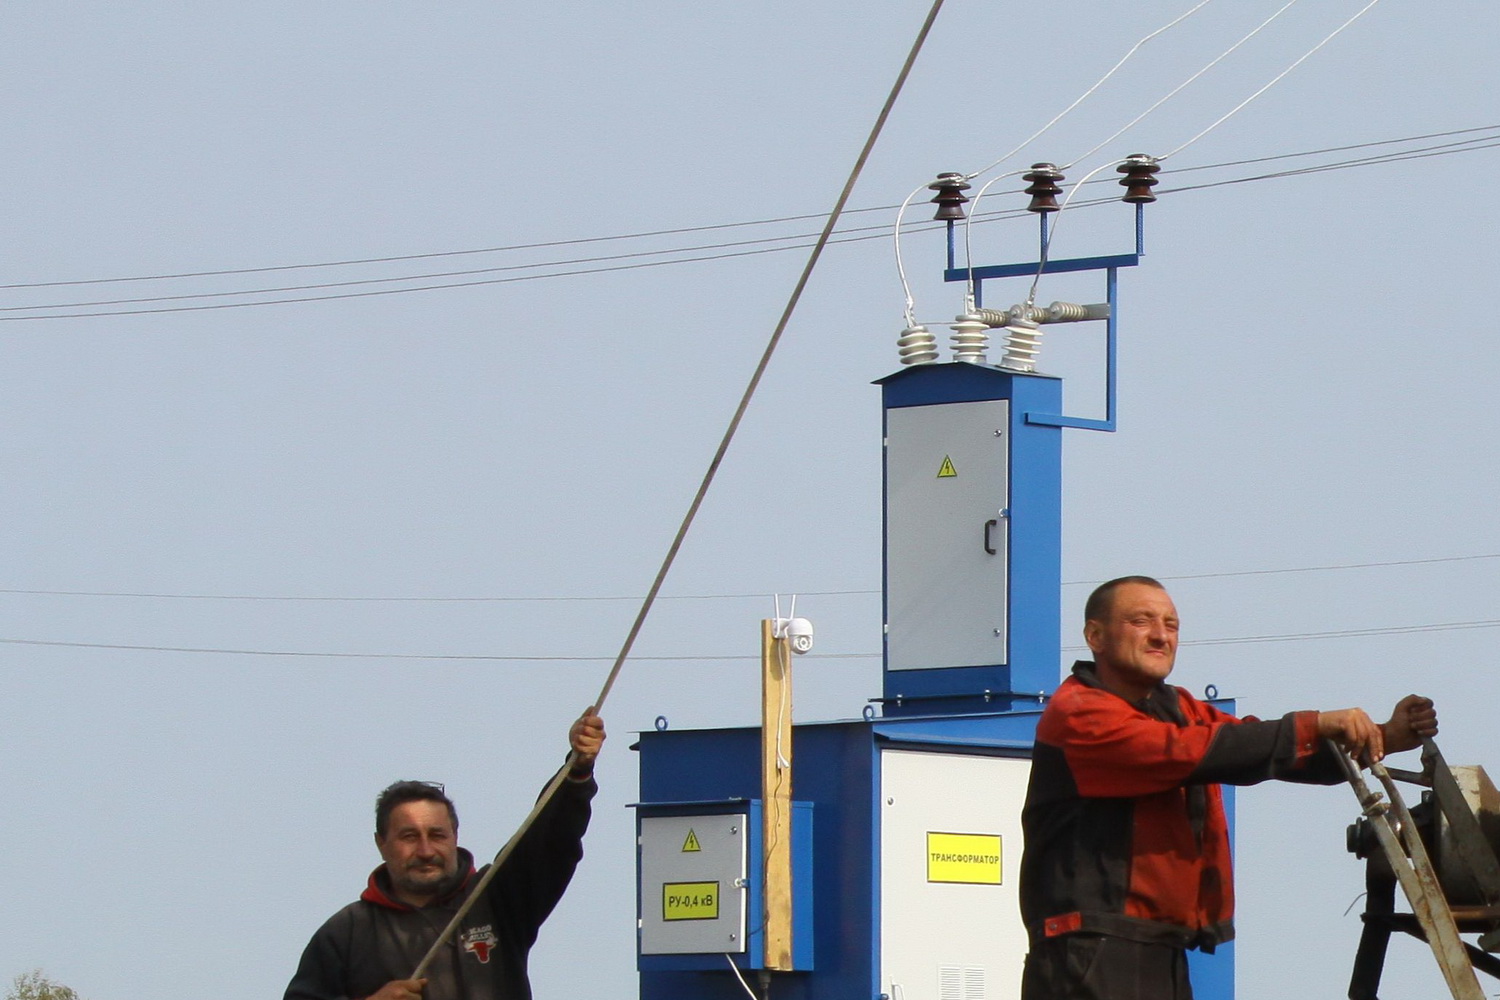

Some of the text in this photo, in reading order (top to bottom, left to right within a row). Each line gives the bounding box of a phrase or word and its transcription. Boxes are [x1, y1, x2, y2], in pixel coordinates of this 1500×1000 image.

[931, 853, 1000, 864] ТРАНСФОРМАТОР
[669, 895, 713, 909] РУ-0,4 кВ
